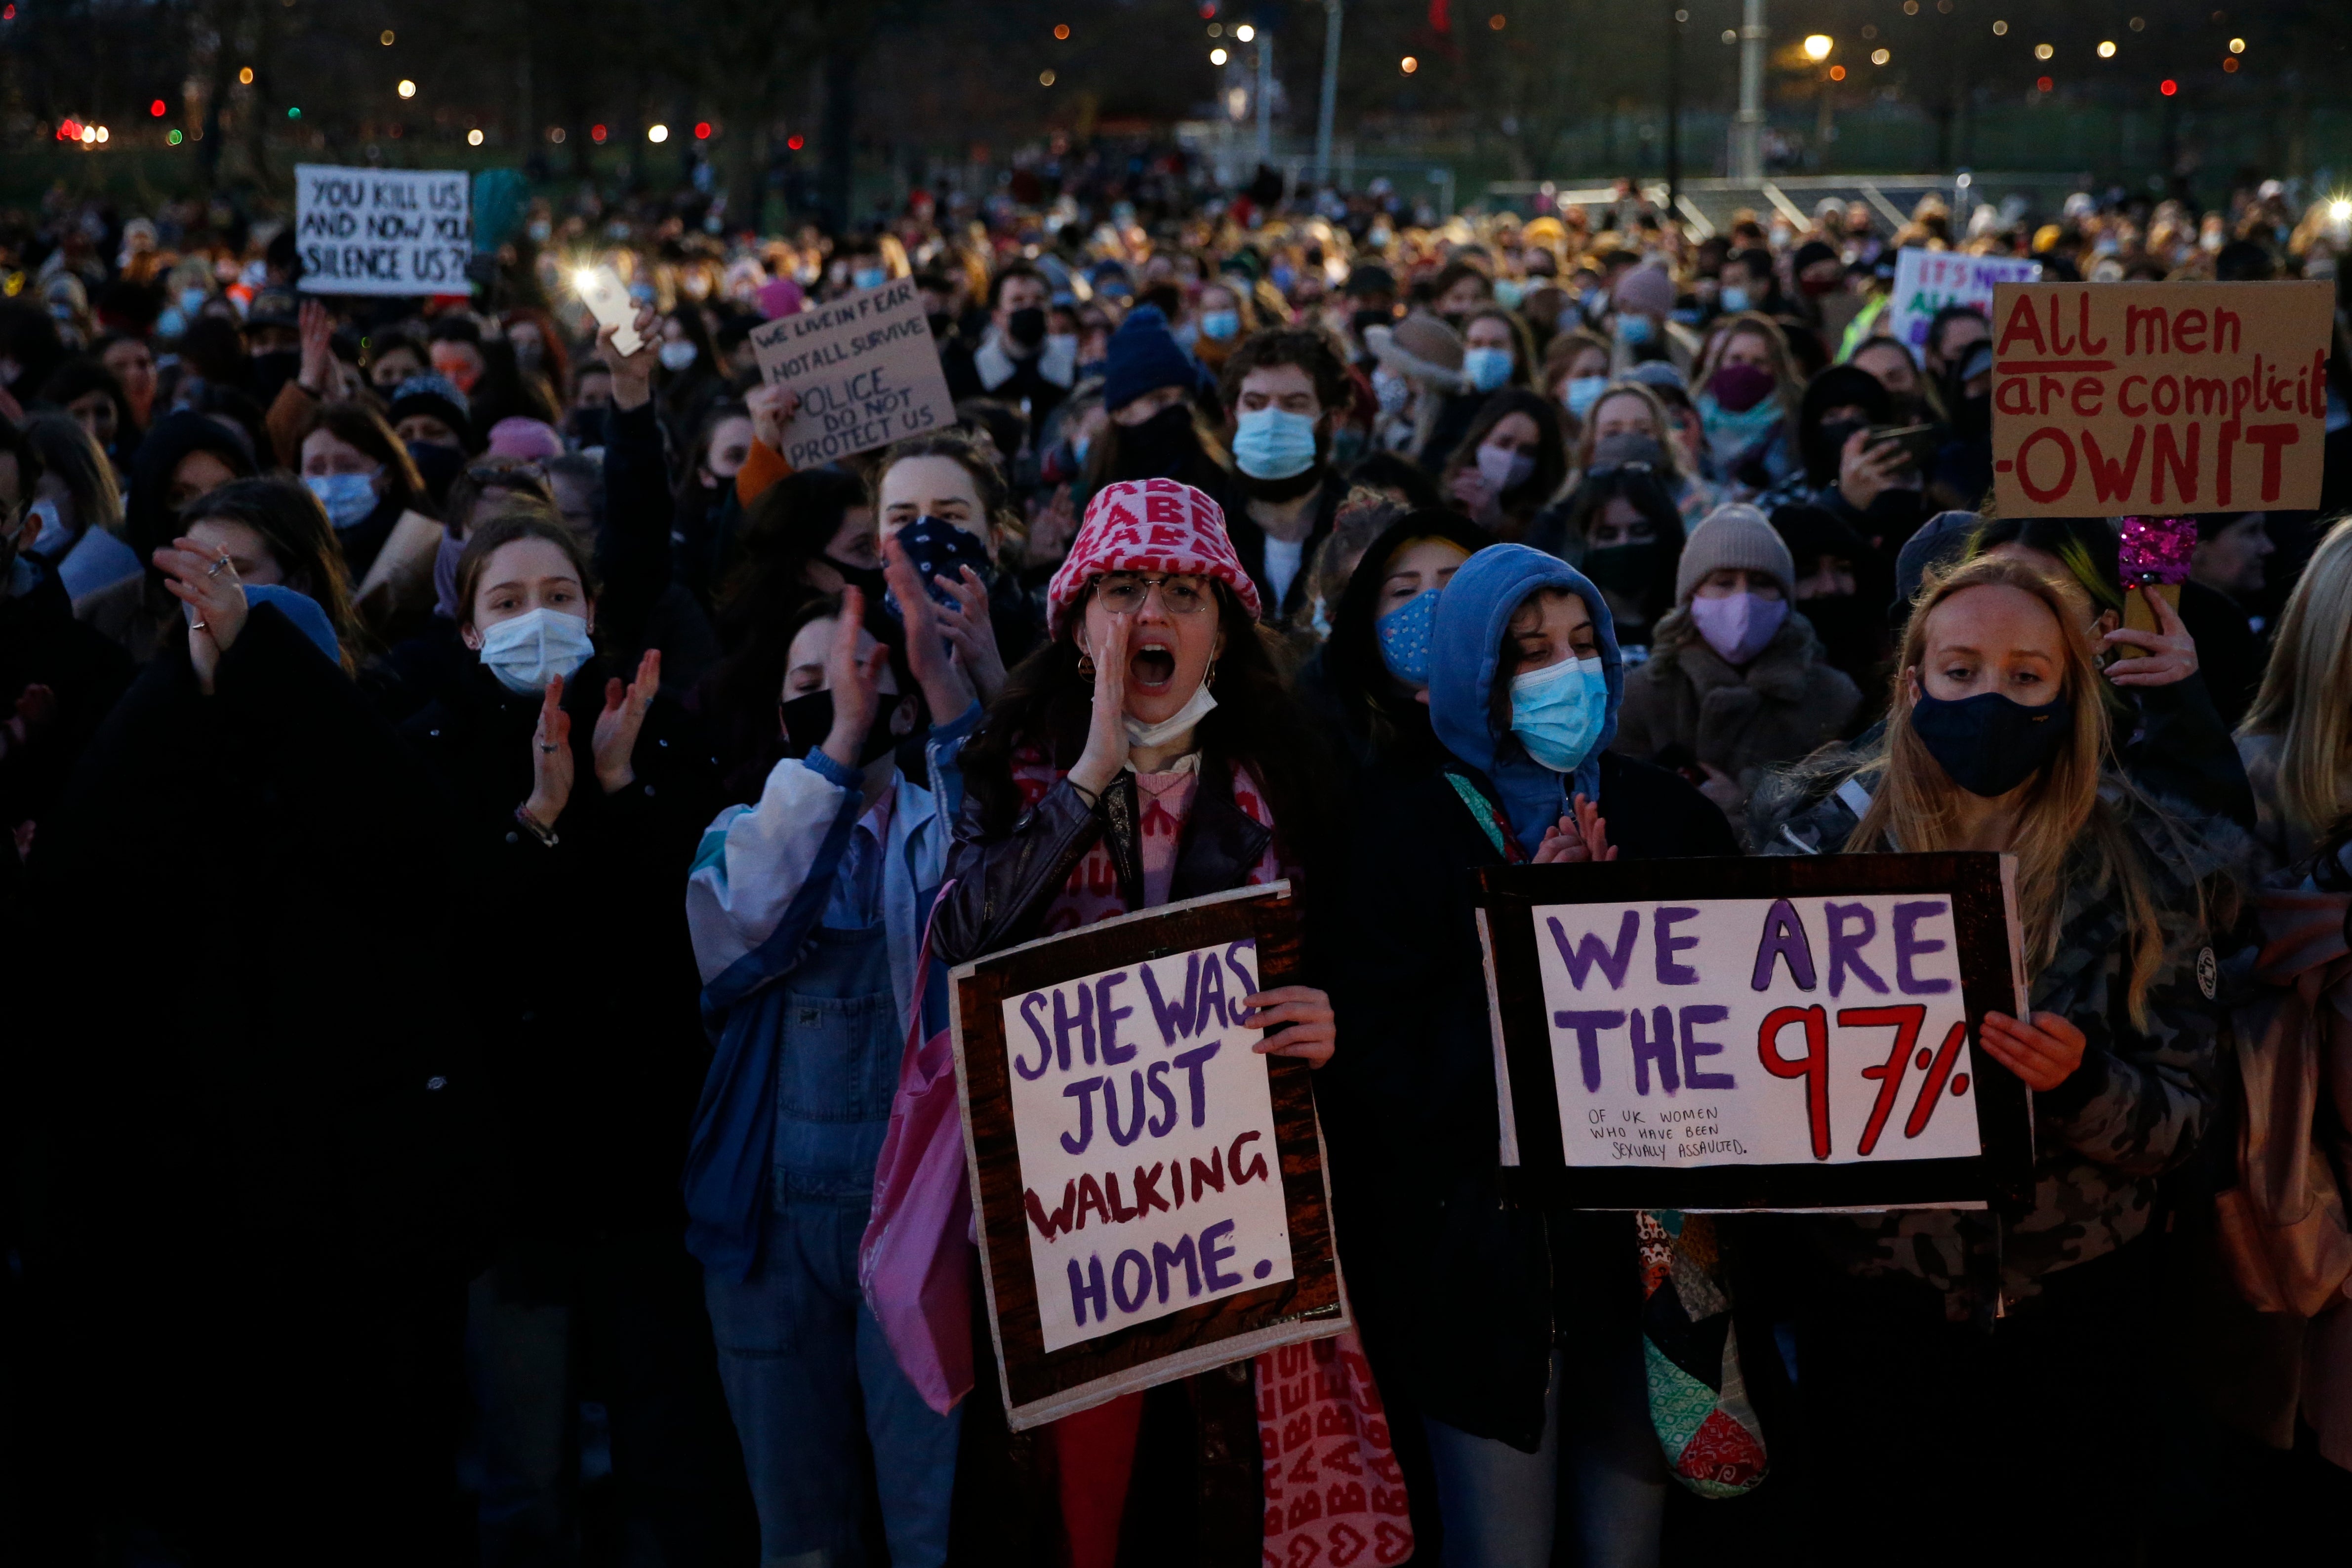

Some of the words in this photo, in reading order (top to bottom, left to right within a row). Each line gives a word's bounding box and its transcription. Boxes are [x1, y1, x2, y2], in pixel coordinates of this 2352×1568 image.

[302, 211, 357, 239] AND
[367, 213, 425, 239] NOW
[312, 177, 365, 207] YOU
[372, 181, 418, 210] KILL
[428, 180, 461, 210] US
[305, 245, 404, 281] SILENCE
[756, 326, 788, 349] WE
[794, 313, 836, 337] LIVE
[839, 306, 855, 324] IN
[858, 283, 914, 317] FEAR
[2125, 304, 2241, 356] men
[771, 352, 811, 383] NOT
[811, 342, 848, 369] ALL
[851, 316, 926, 356] SURVIVE
[796, 366, 891, 418] OLICE
[823, 409, 856, 432] DO
[864, 387, 913, 418] NOT
[1995, 375, 2105, 416] are
[2118, 348, 2328, 441] complicit
[791, 418, 890, 469] PROTECT
[902, 405, 935, 430] US
[1545, 906, 1701, 991] WE
[1751, 897, 1958, 1000] ARE
[1014, 971, 1138, 1081] SHE
[1140, 937, 1258, 1047] WAS
[1059, 1039, 1221, 1156] JUST
[1553, 1004, 1739, 1098] THE
[1757, 1003, 1971, 1161] 97%
[1589, 1109, 1606, 1124] OF
[1622, 1110, 1646, 1124] UK
[1660, 1107, 1718, 1123] WOMEN
[1590, 1127, 1626, 1139] WHO
[1638, 1129, 1672, 1140] HAVE
[1686, 1124, 1718, 1137] BEEN
[1612, 1141, 1665, 1161] SEXUALLY
[1679, 1139, 1747, 1158] ASSAULTED.
[1023, 1130, 1268, 1244] WALKING
[1066, 1218, 1272, 1327] HOME.
